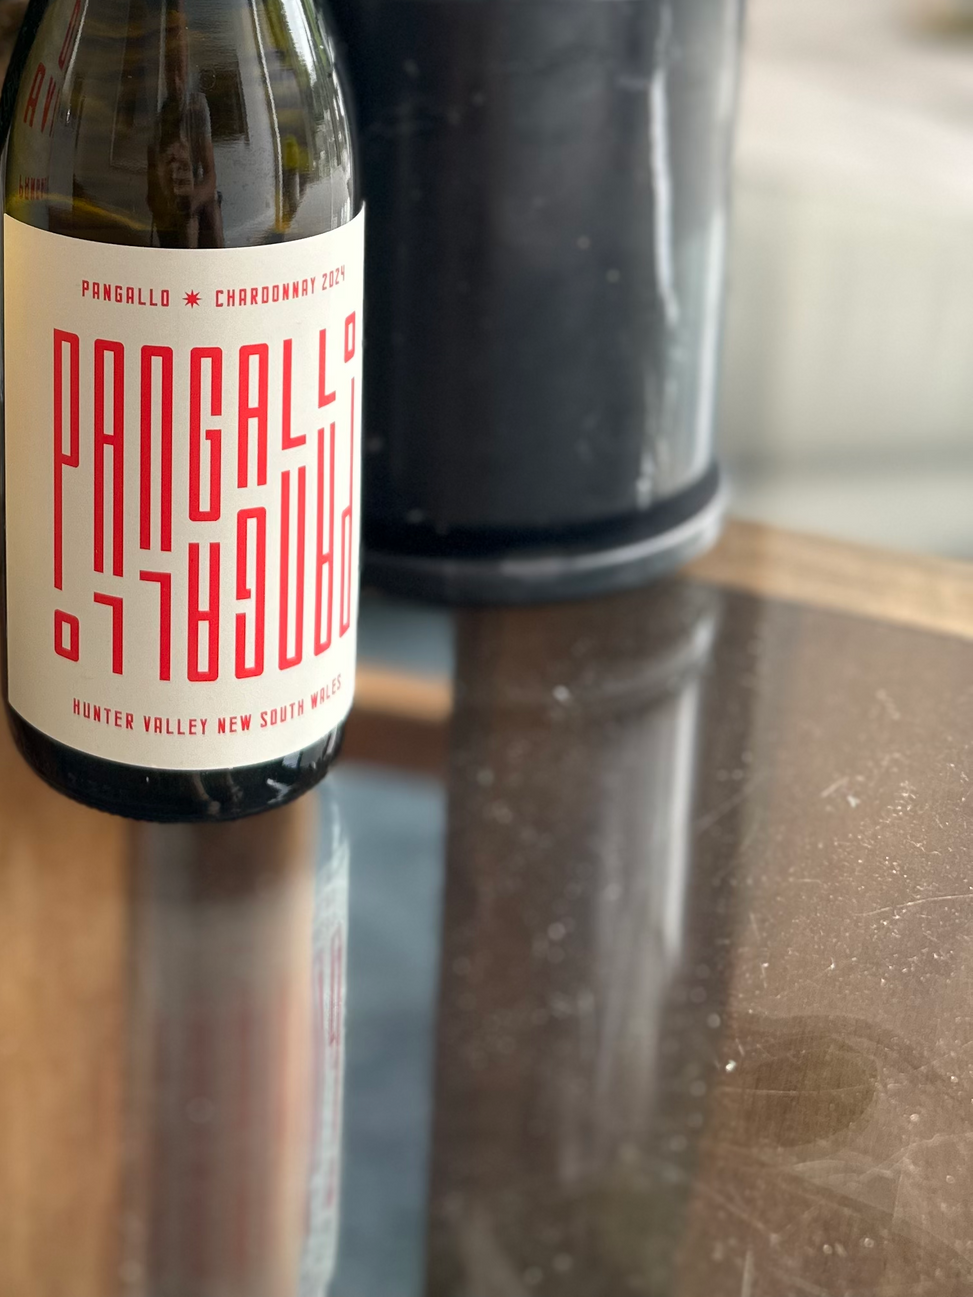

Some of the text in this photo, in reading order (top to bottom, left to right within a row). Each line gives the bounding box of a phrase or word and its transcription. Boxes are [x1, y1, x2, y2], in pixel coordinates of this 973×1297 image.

[81, 264, 345, 308] PANGALLO CHARDONNAY 2024
[72, 673, 342, 736] HUNTER VALLEY NEW SOUTH WALES
